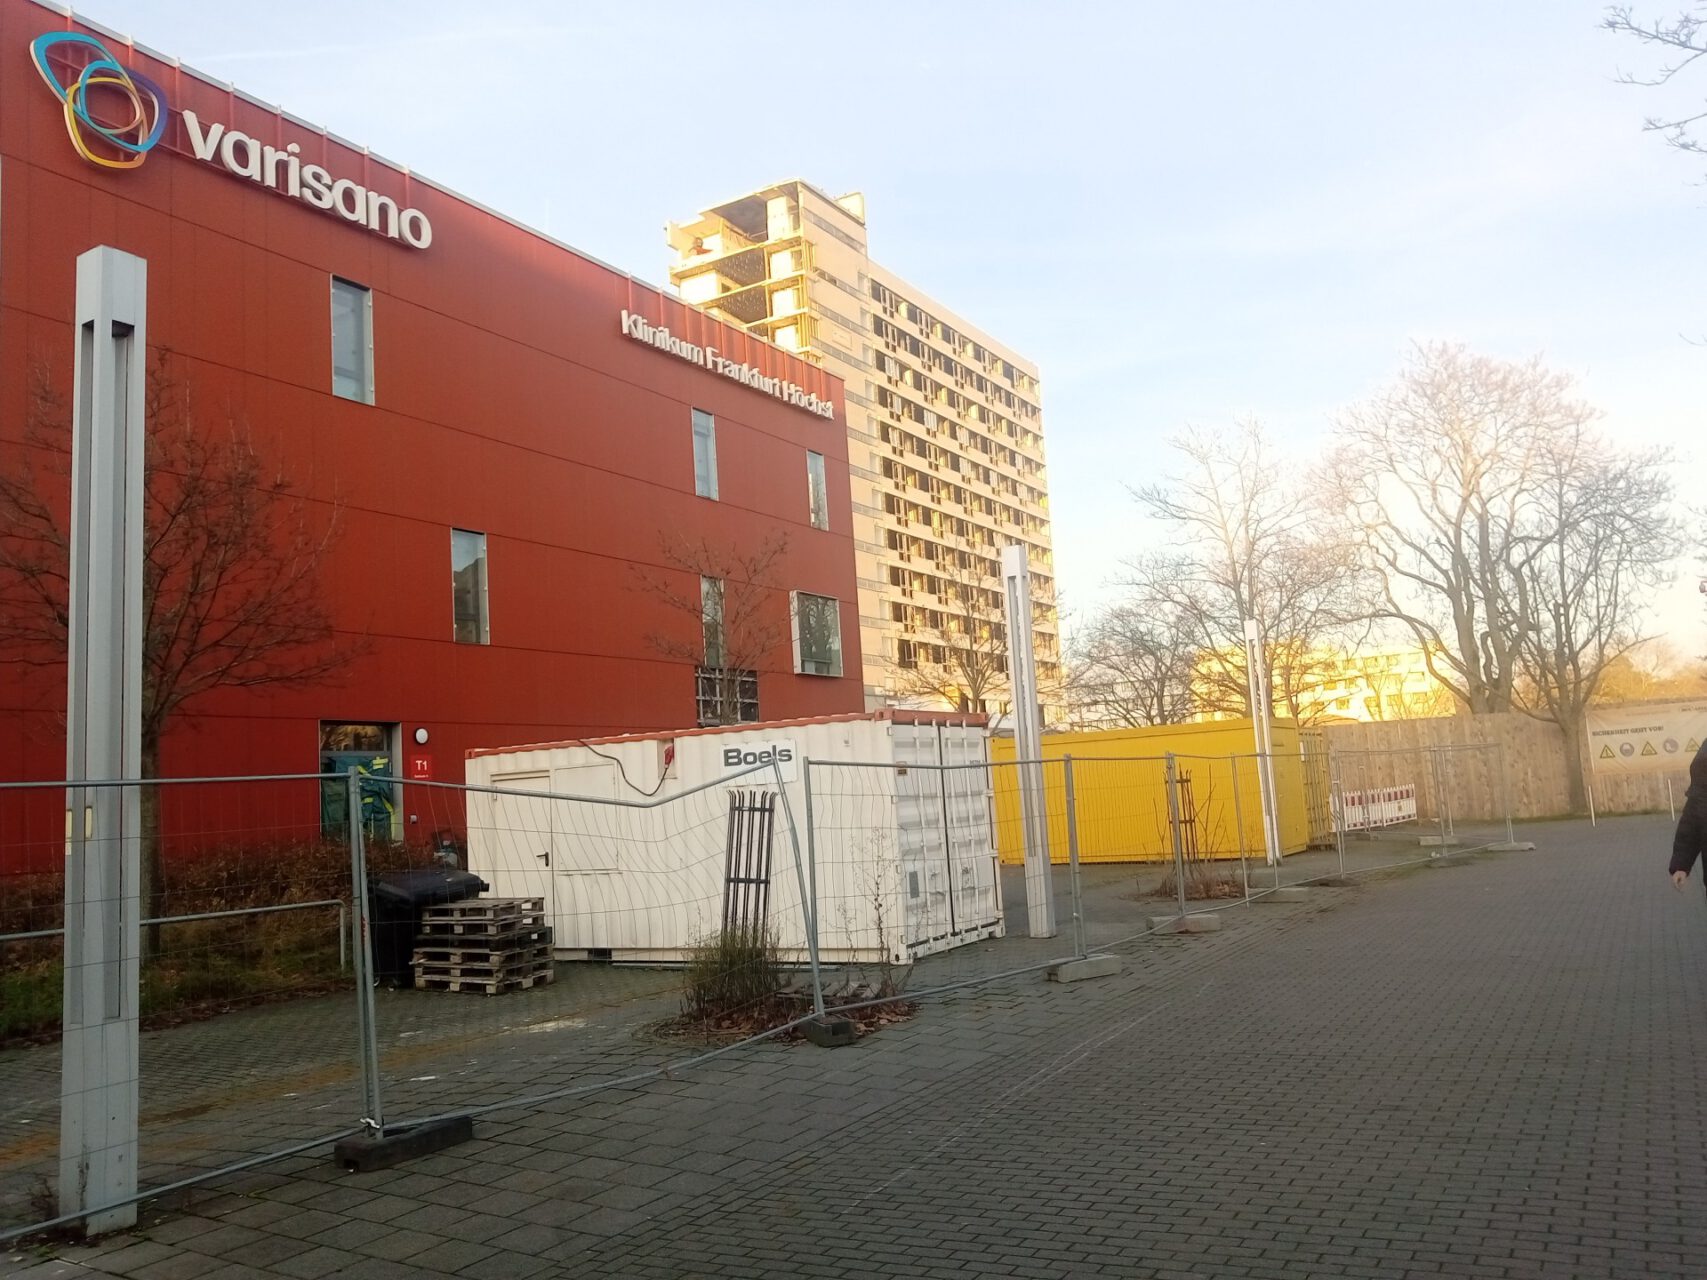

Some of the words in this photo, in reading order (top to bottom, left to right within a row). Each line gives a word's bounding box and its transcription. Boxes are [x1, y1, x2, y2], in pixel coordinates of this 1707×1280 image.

[183, 110, 432, 249] varisano
[621, 310, 704, 365] Klinikum
[705, 346, 781, 398] Frankfurt
[782, 380, 834, 420] Höchst
[415, 760, 428, 771] T1
[723, 745, 793, 767] Boels
